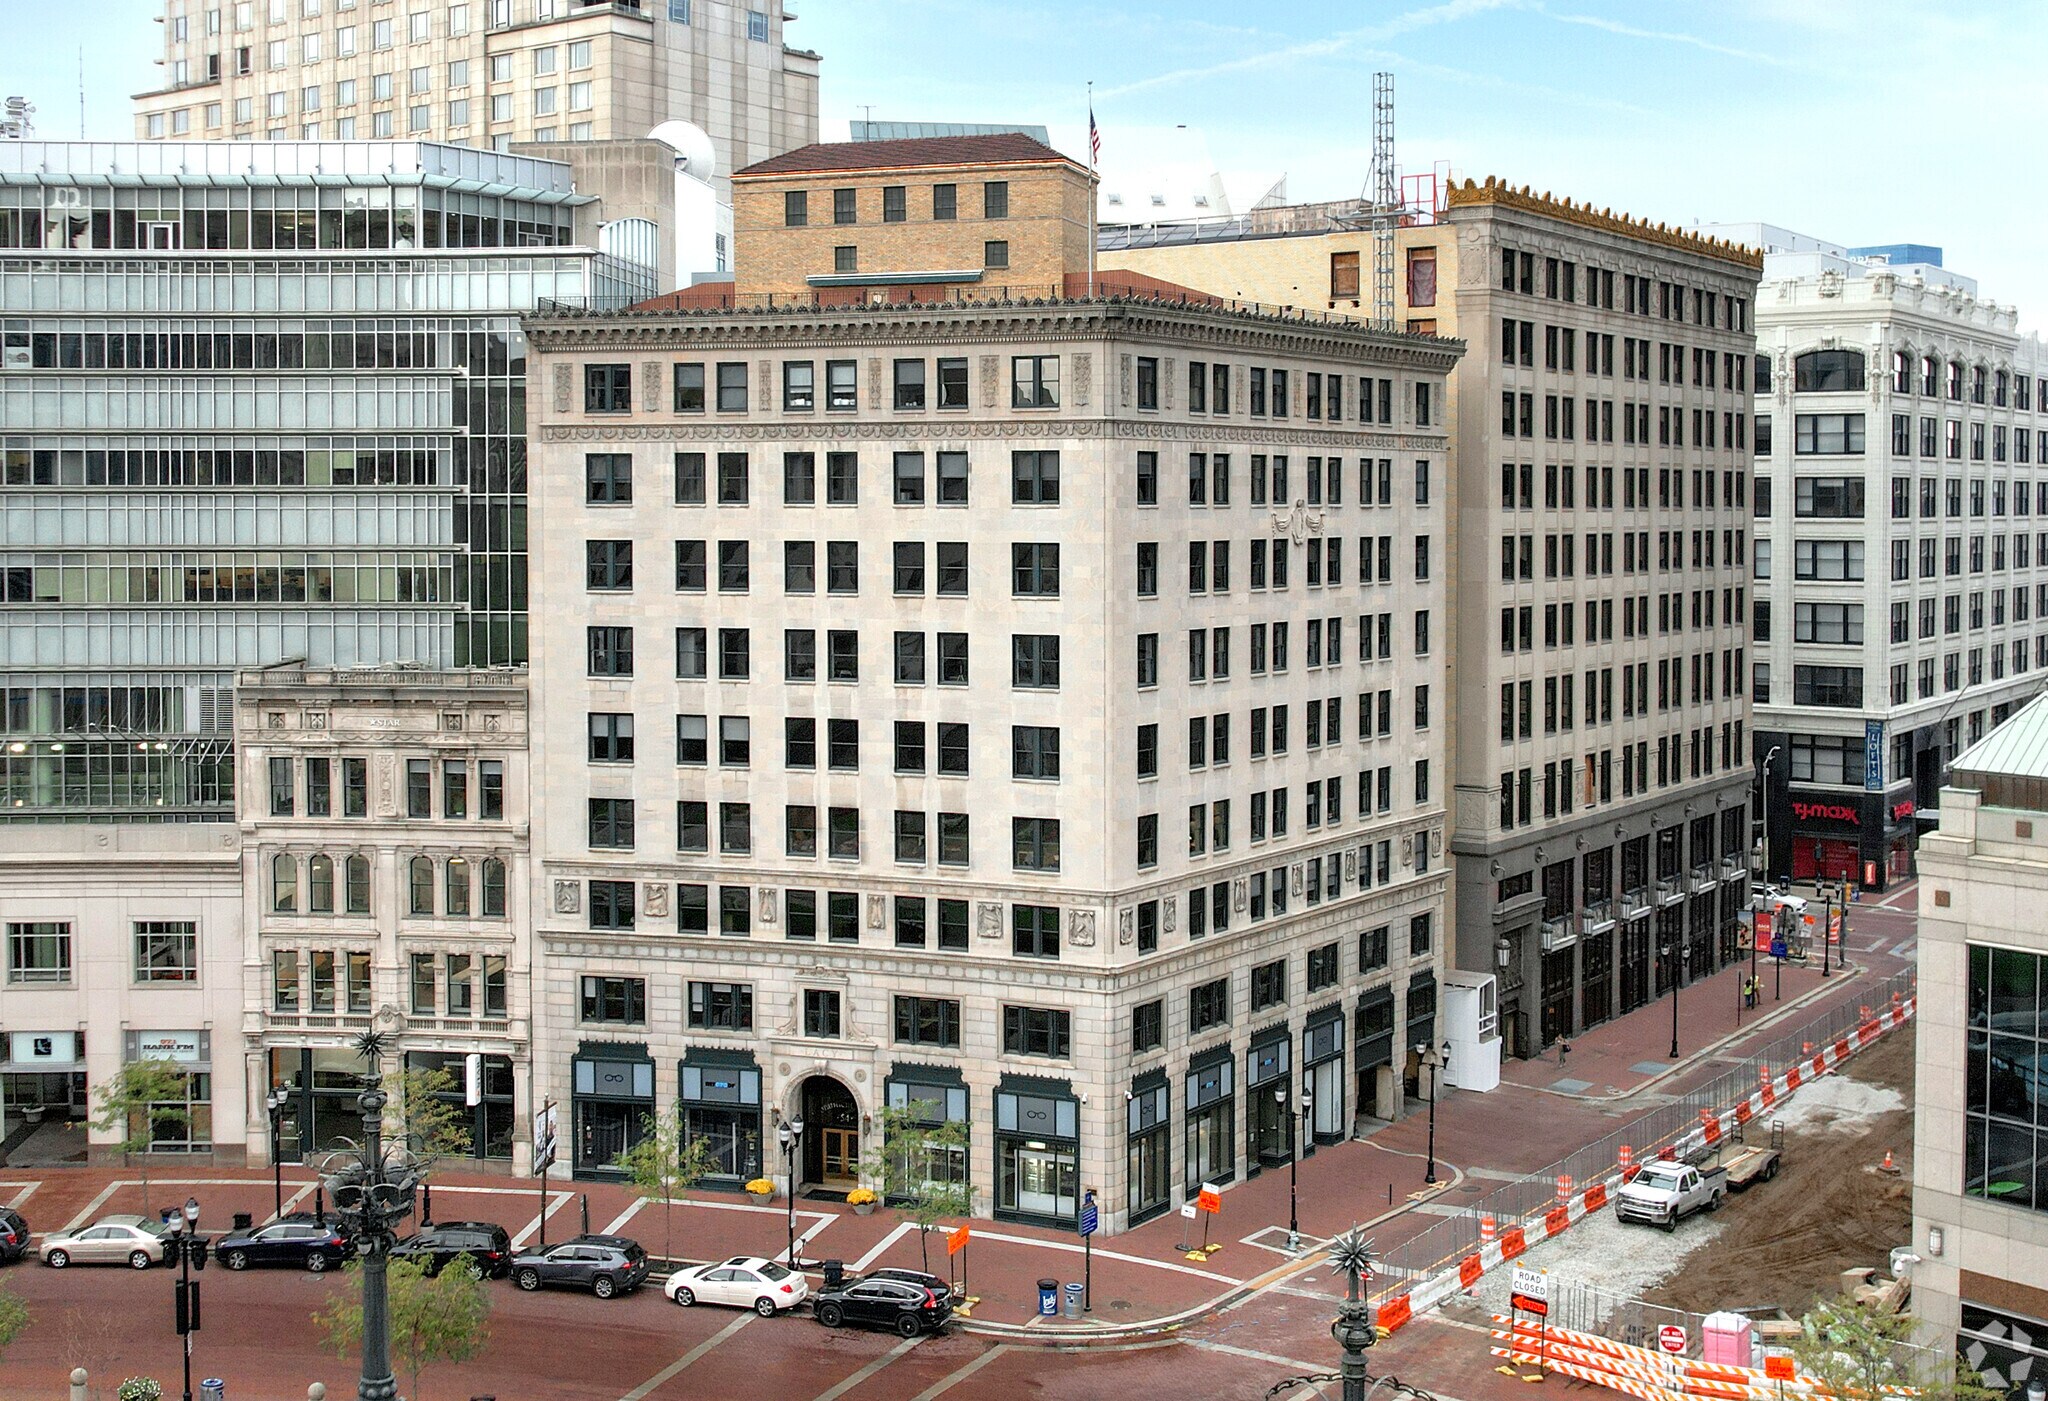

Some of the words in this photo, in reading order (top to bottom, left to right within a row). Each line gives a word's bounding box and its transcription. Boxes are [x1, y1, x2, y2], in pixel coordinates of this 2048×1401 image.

[377, 719, 401, 727] STAR
[1869, 733, 1878, 778] LOFTS
[804, 1048, 839, 1058] LACY
[1519, 1271, 1542, 1284] ROAD
[1513, 1280, 1546, 1295] CLOSED
